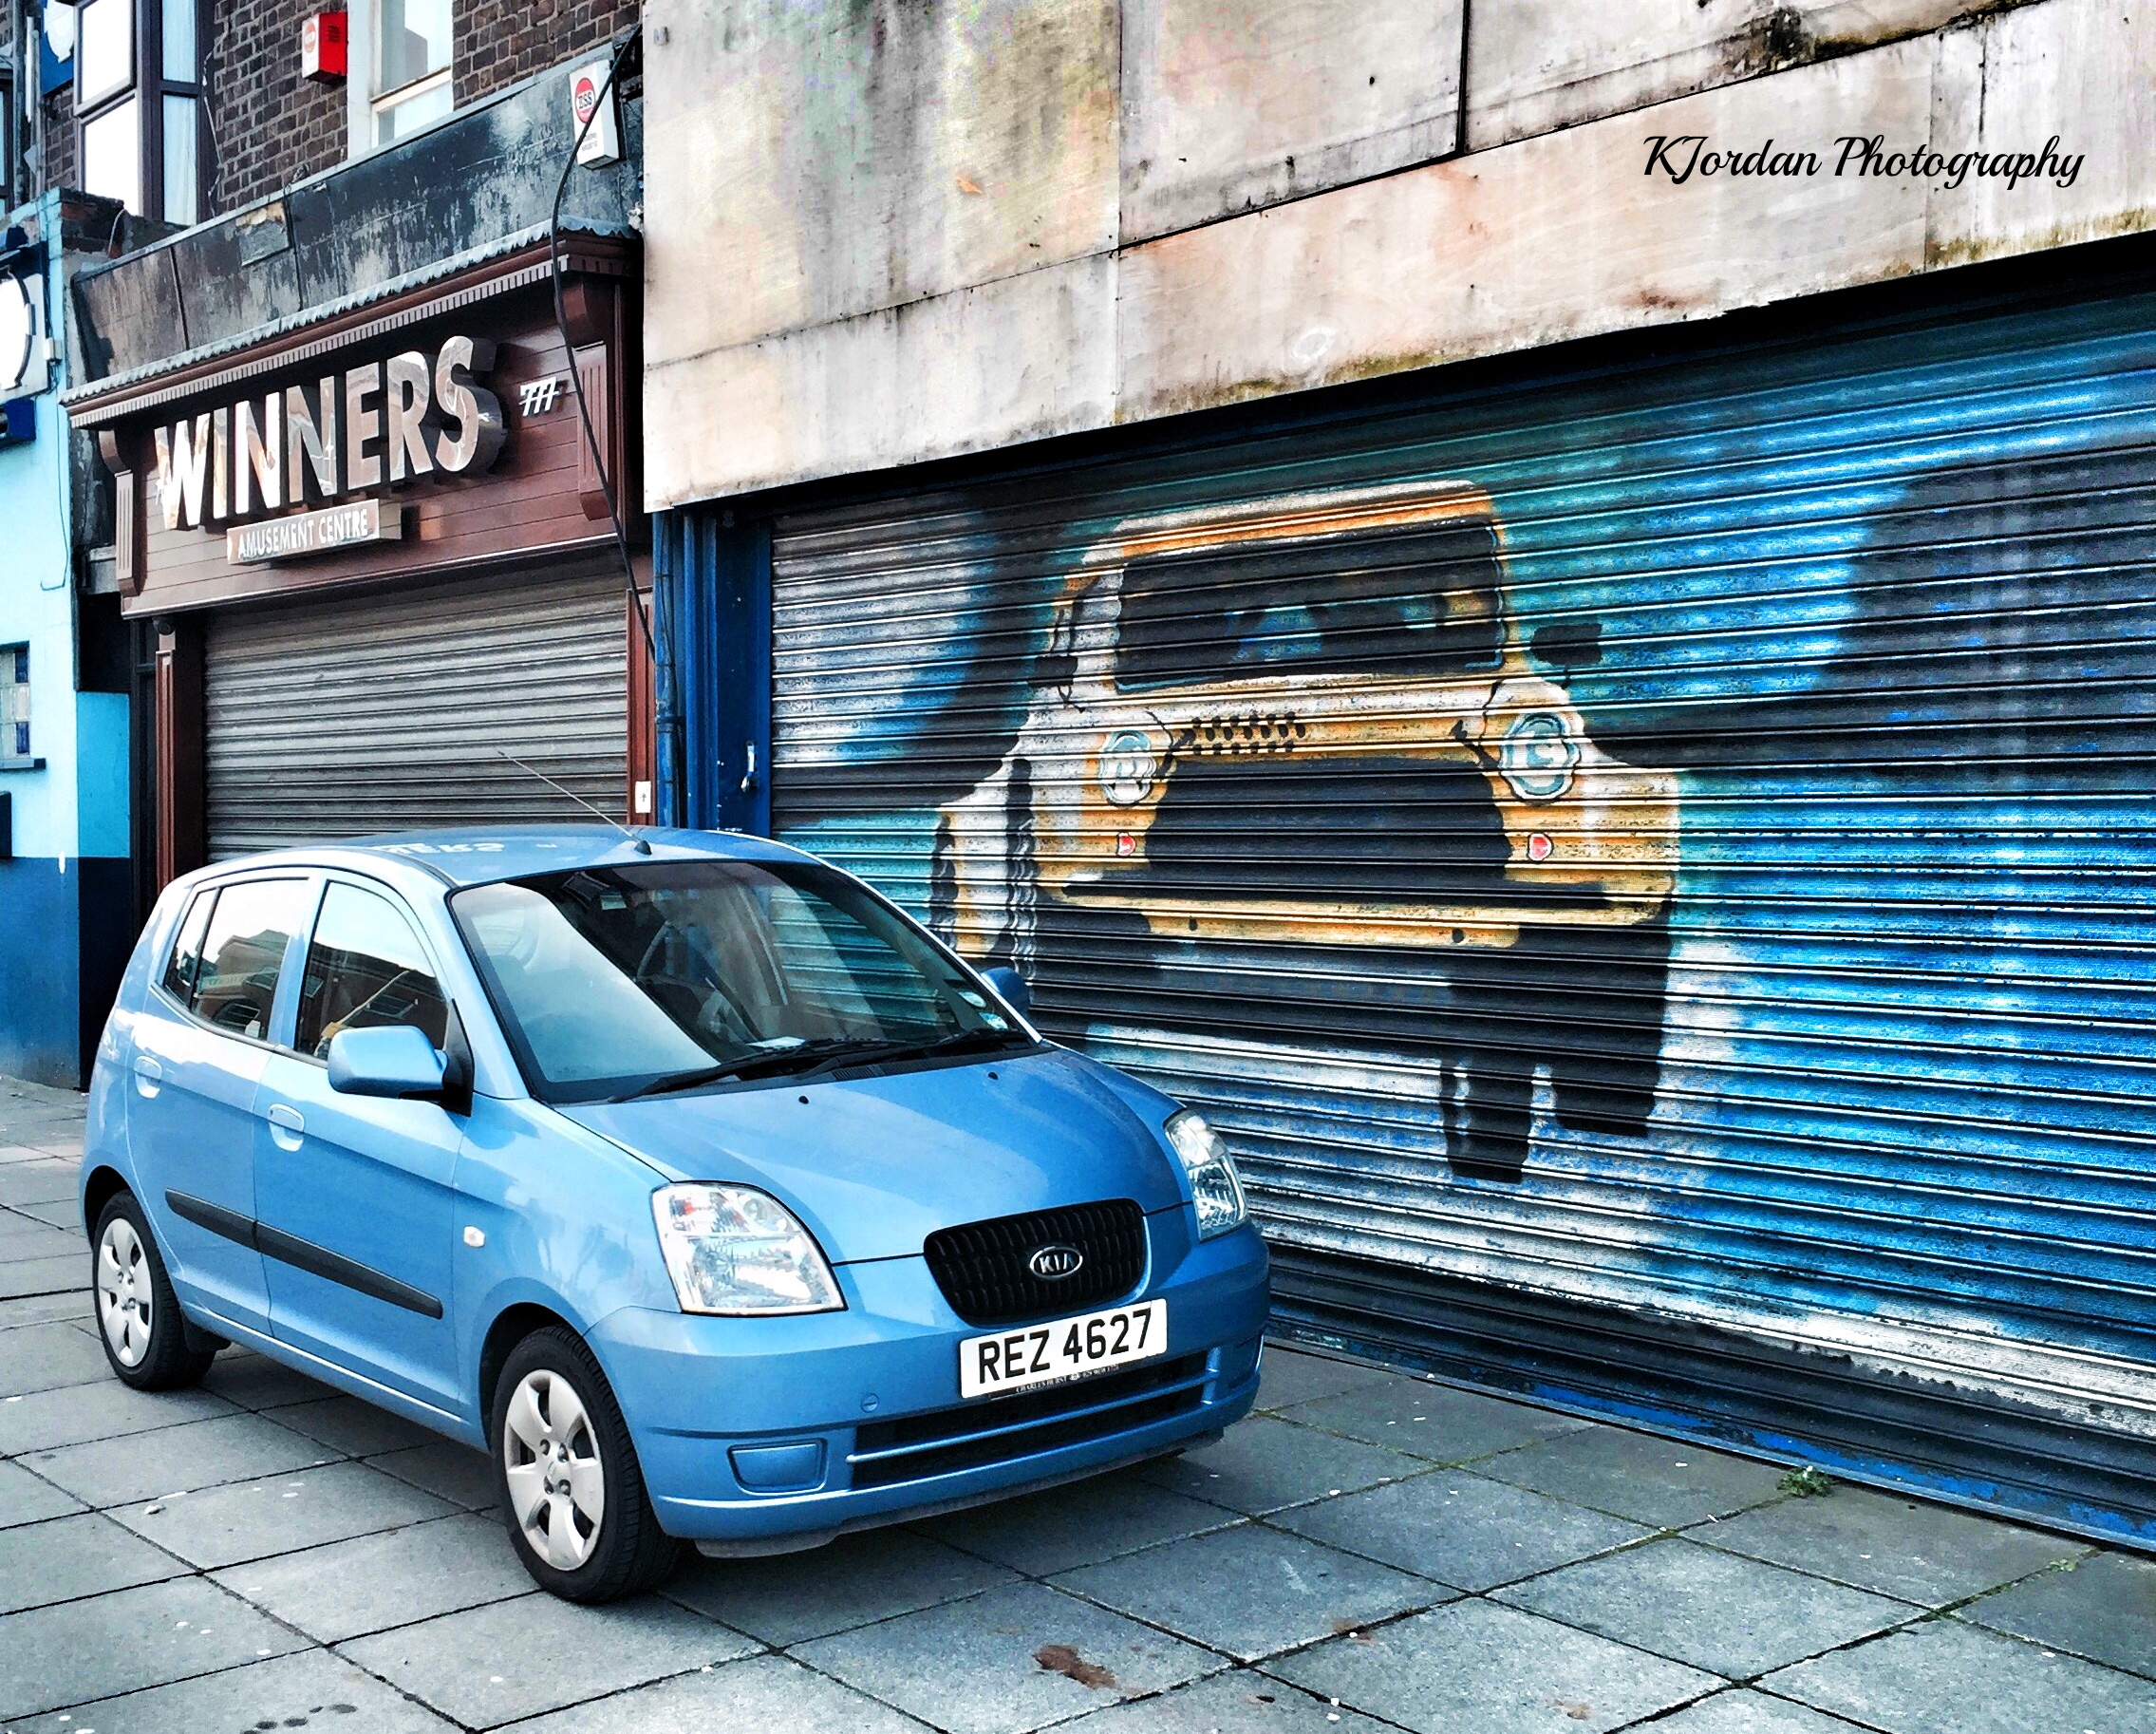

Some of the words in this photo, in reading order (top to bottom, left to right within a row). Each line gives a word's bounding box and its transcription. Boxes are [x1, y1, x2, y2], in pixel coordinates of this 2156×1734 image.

[154, 335, 480, 530] WINNERS
[237, 521, 314, 558] AMUSEMENT
[319, 509, 368, 544] CENTRE
[1039, 1253, 1076, 1273] KIA
[979, 1329, 1051, 1385] REZ
[1063, 1307, 1152, 1364] 4627
